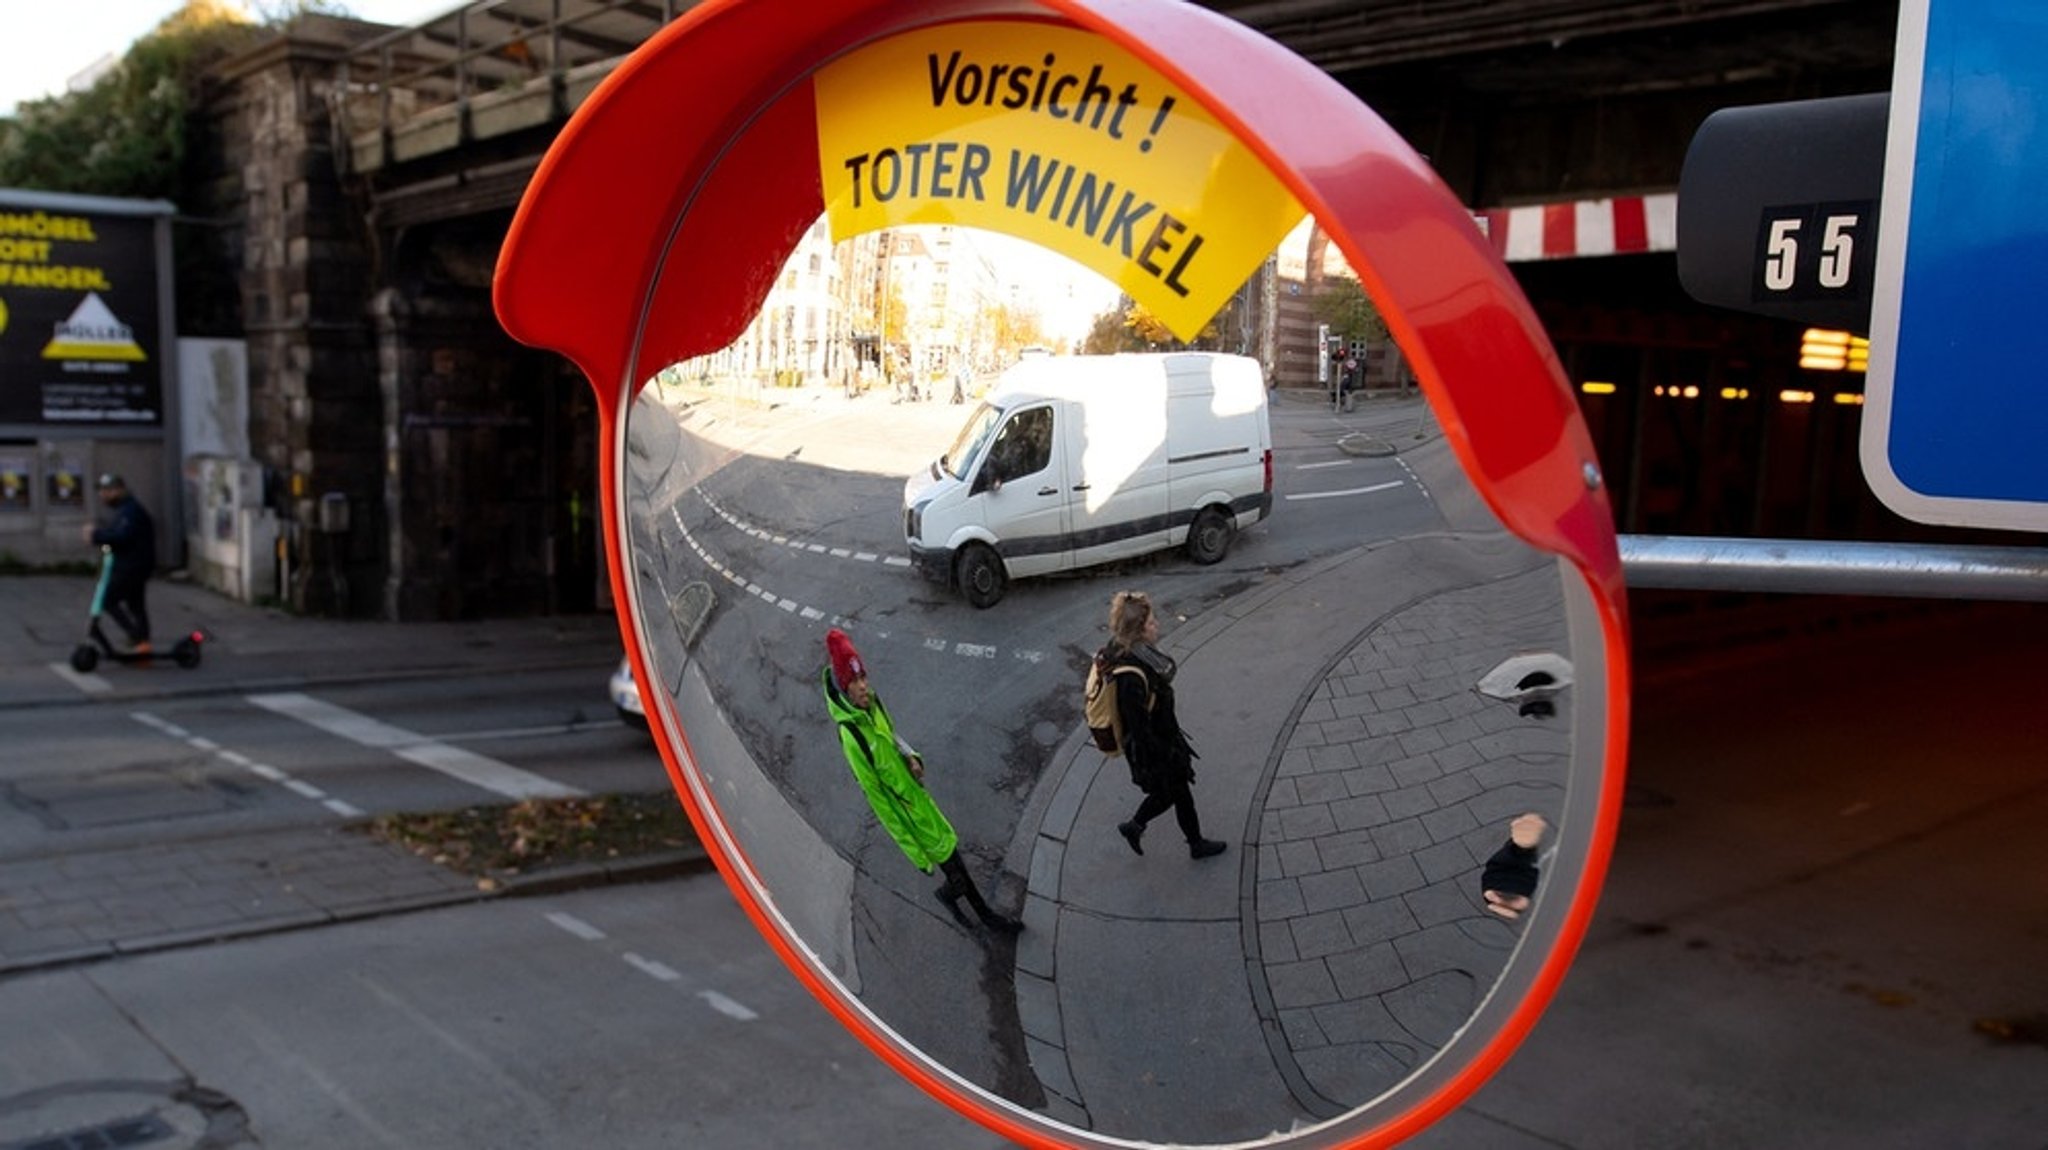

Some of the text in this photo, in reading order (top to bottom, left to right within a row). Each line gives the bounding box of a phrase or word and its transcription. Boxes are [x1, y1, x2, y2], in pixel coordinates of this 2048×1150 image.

[927, 50, 1176, 154] Vorsicht !
[844, 142, 1205, 298] TOTER WINKEL
